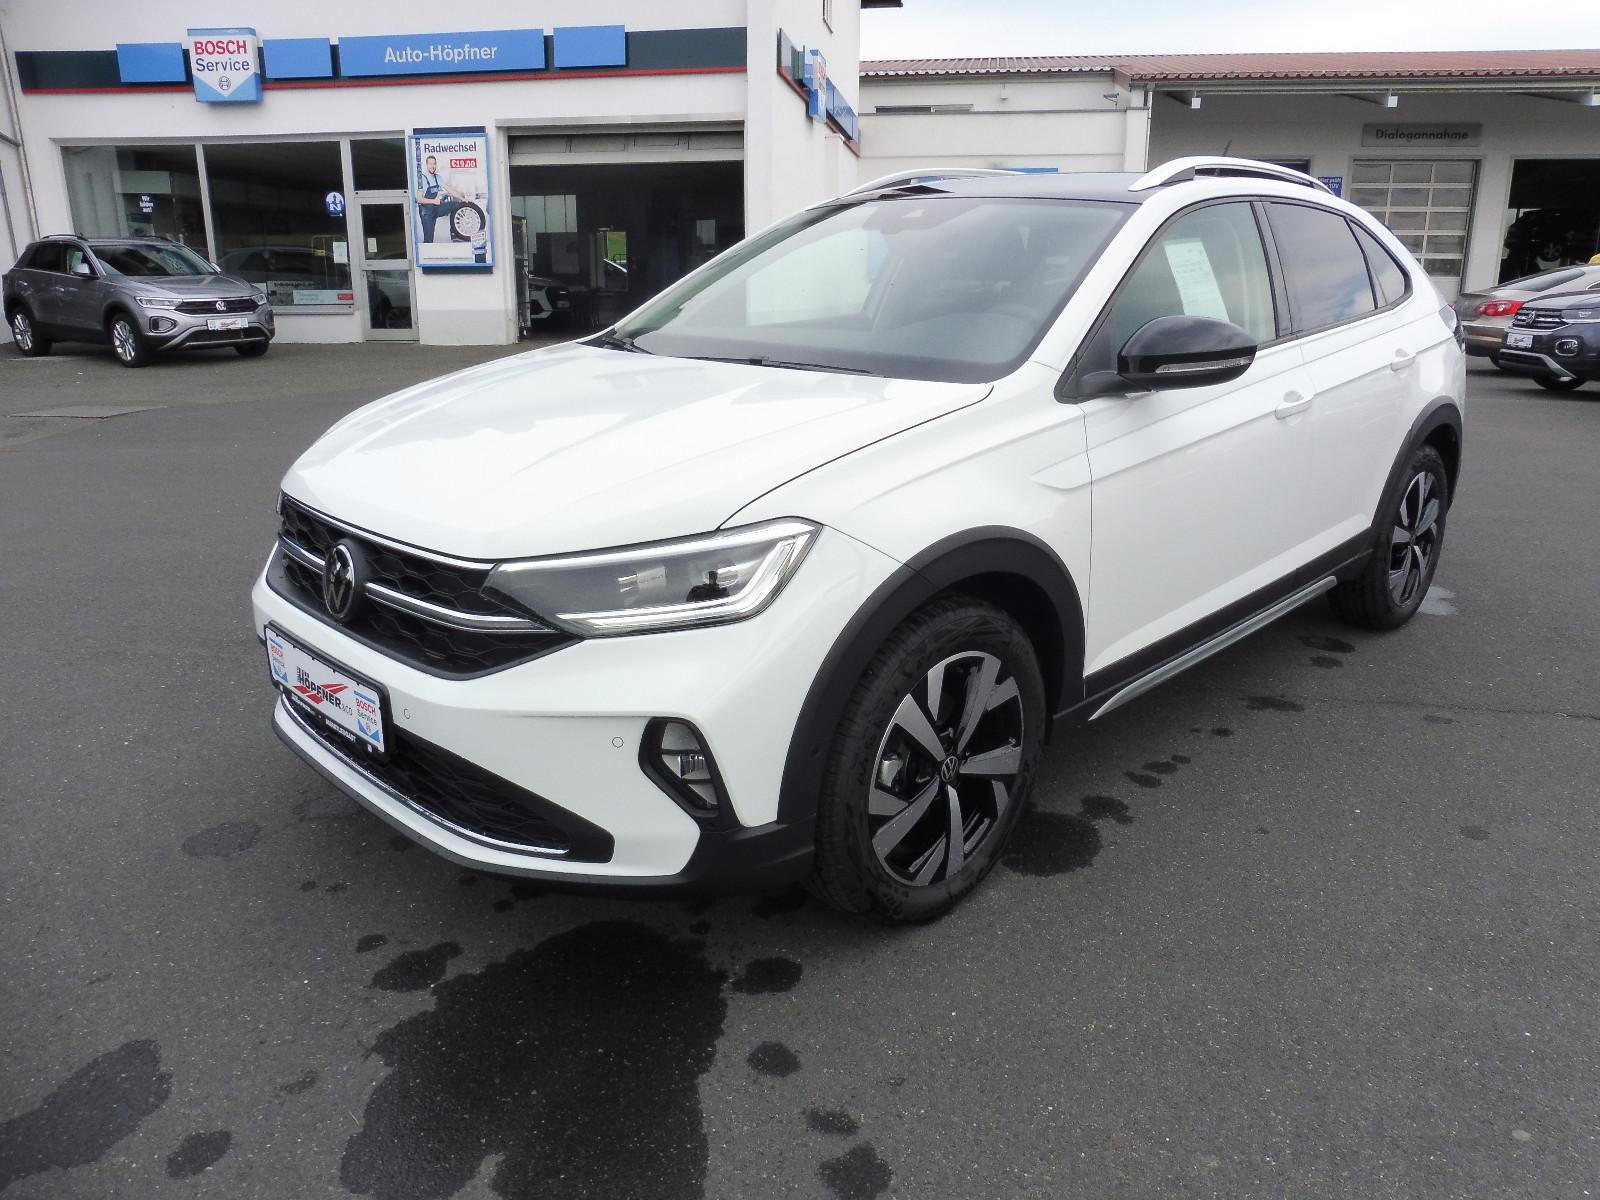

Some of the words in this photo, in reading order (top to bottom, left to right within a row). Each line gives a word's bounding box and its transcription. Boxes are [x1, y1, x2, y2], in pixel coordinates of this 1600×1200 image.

[194, 39, 247, 55] BOSCH
[384, 44, 498, 64] Auto-Höpfner
[195, 57, 250, 72] Service
[1375, 127, 1470, 143] Dialogannahme
[423, 141, 477, 153] Radwechsel
[355, 697, 377, 715] BOSCH
[356, 709, 378, 727] Service
